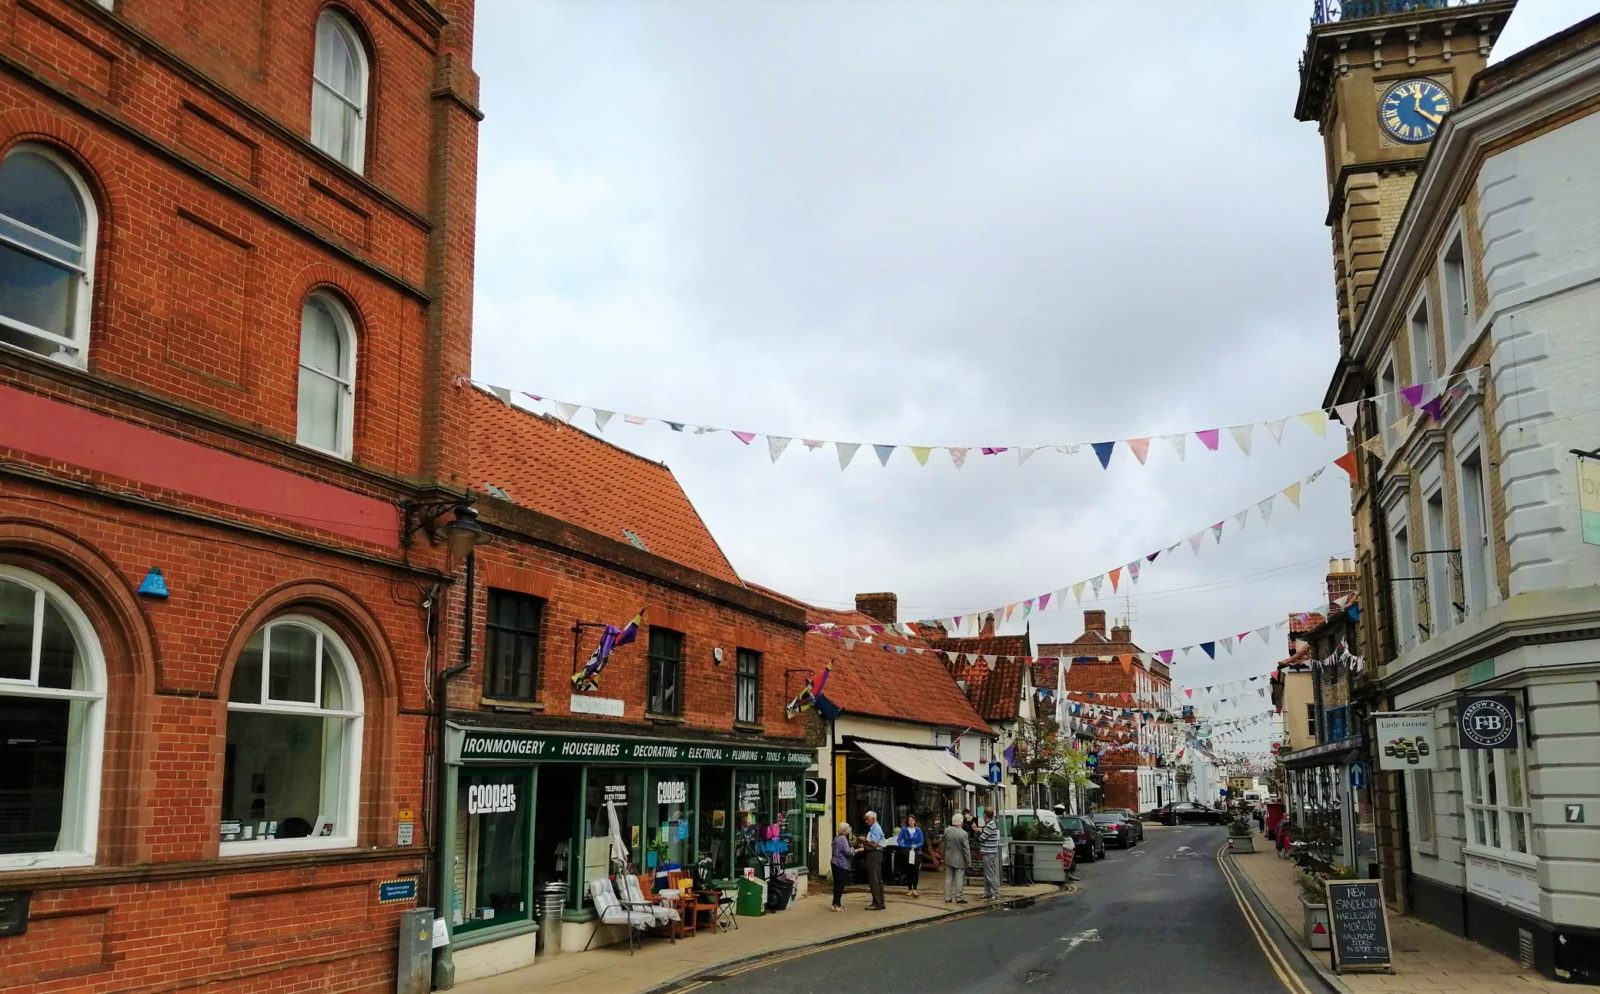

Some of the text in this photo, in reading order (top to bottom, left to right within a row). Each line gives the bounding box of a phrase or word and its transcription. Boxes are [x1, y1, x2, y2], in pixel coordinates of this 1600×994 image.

[1496, 705, 1509, 719] BALL
[1381, 721, 1400, 729] Little
[463, 738, 812, 763] IRONMONGERY HOUSEWARES DECORATING ELECTRICAL PLUMBING TOOLS GARDENING
[1568, 805, 1580, 820] 7
[1347, 888, 1366, 898] NEW
[1336, 898, 1382, 911] SANDERSON
[1336, 911, 1377, 920] HARLEQUIN
[1343, 920, 1376, 931] MORRIS
